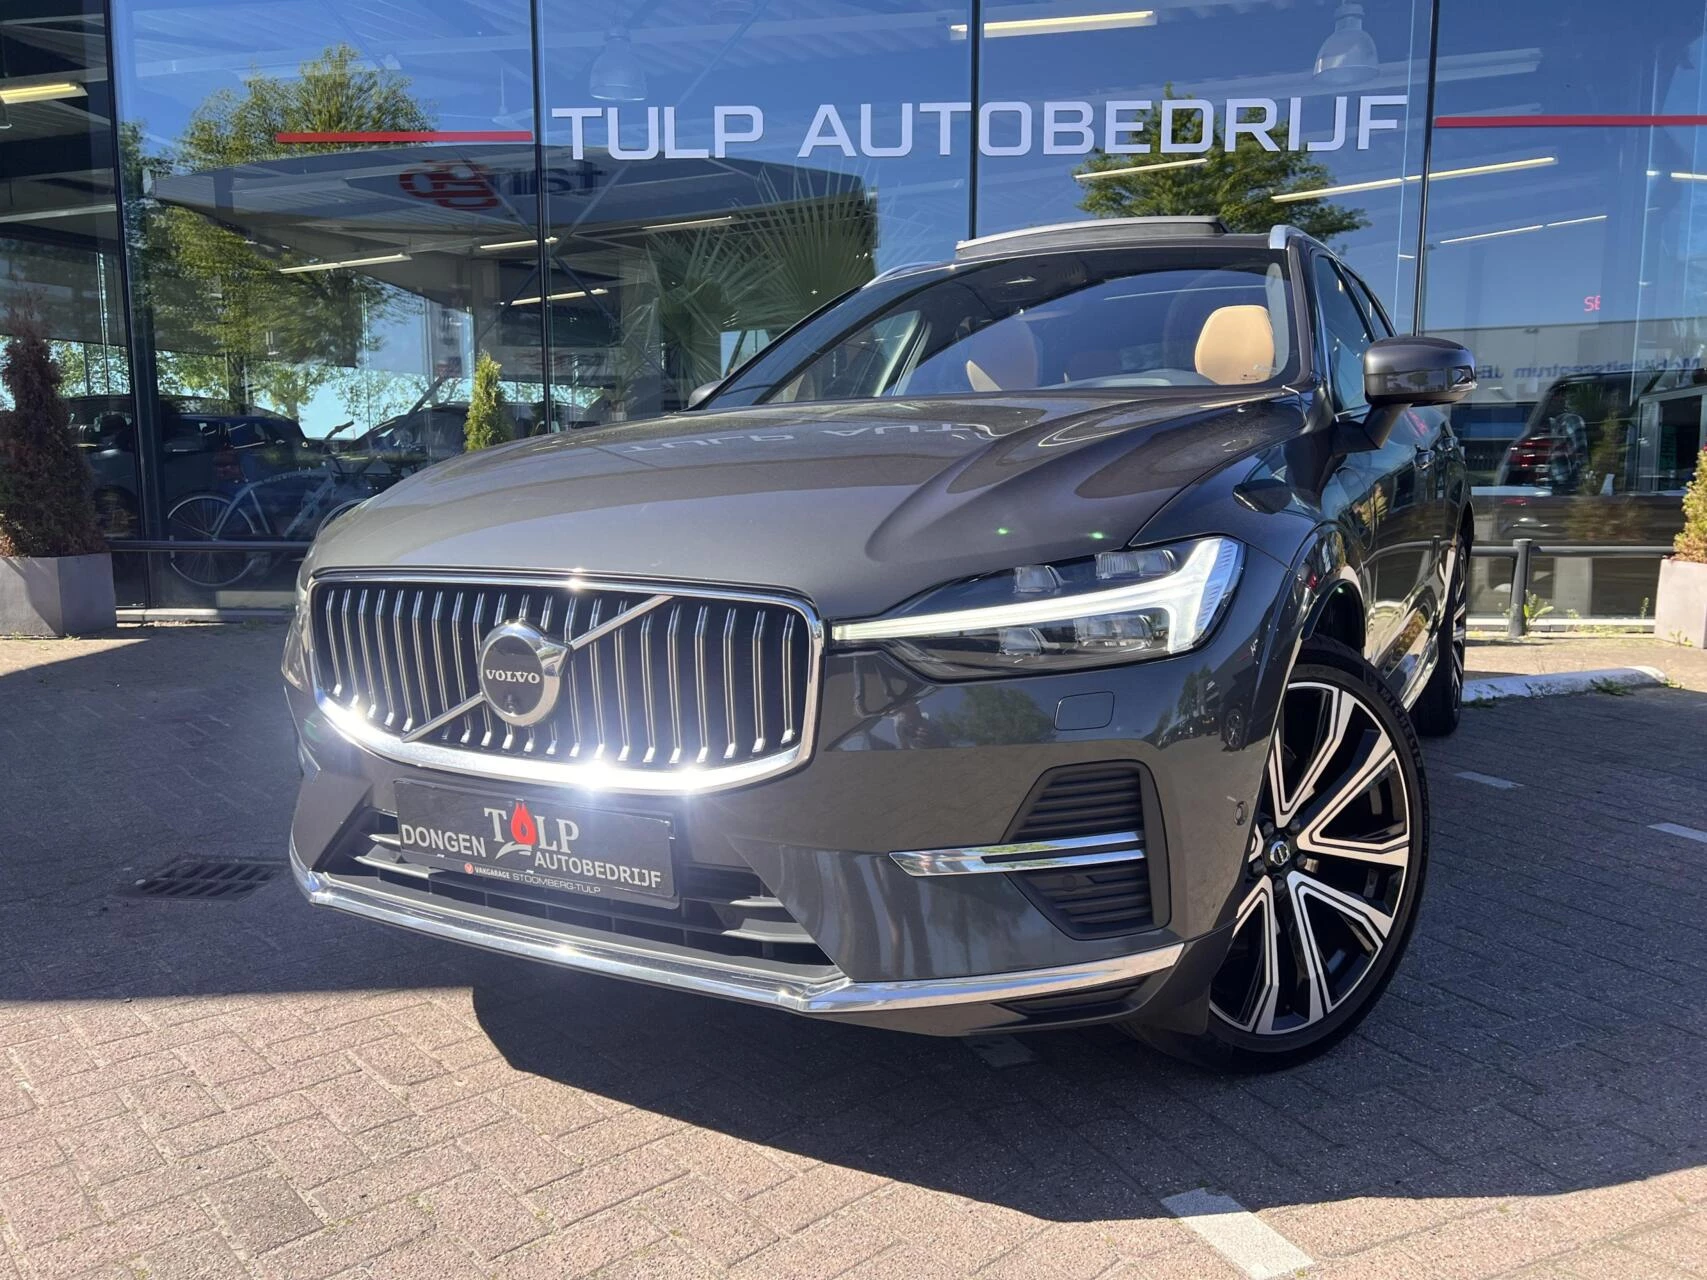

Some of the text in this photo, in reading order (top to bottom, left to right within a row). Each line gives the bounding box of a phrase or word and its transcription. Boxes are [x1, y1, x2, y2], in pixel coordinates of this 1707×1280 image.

[551, 95, 1408, 160] TULP AUTOBEDRIJF
[485, 669, 541, 684] VOLVO
[401, 823, 487, 858] DONGEN
[513, 873, 601, 895] STOOMBERG-TULP
[534, 851, 662, 889] AUTOBEDRIJF
